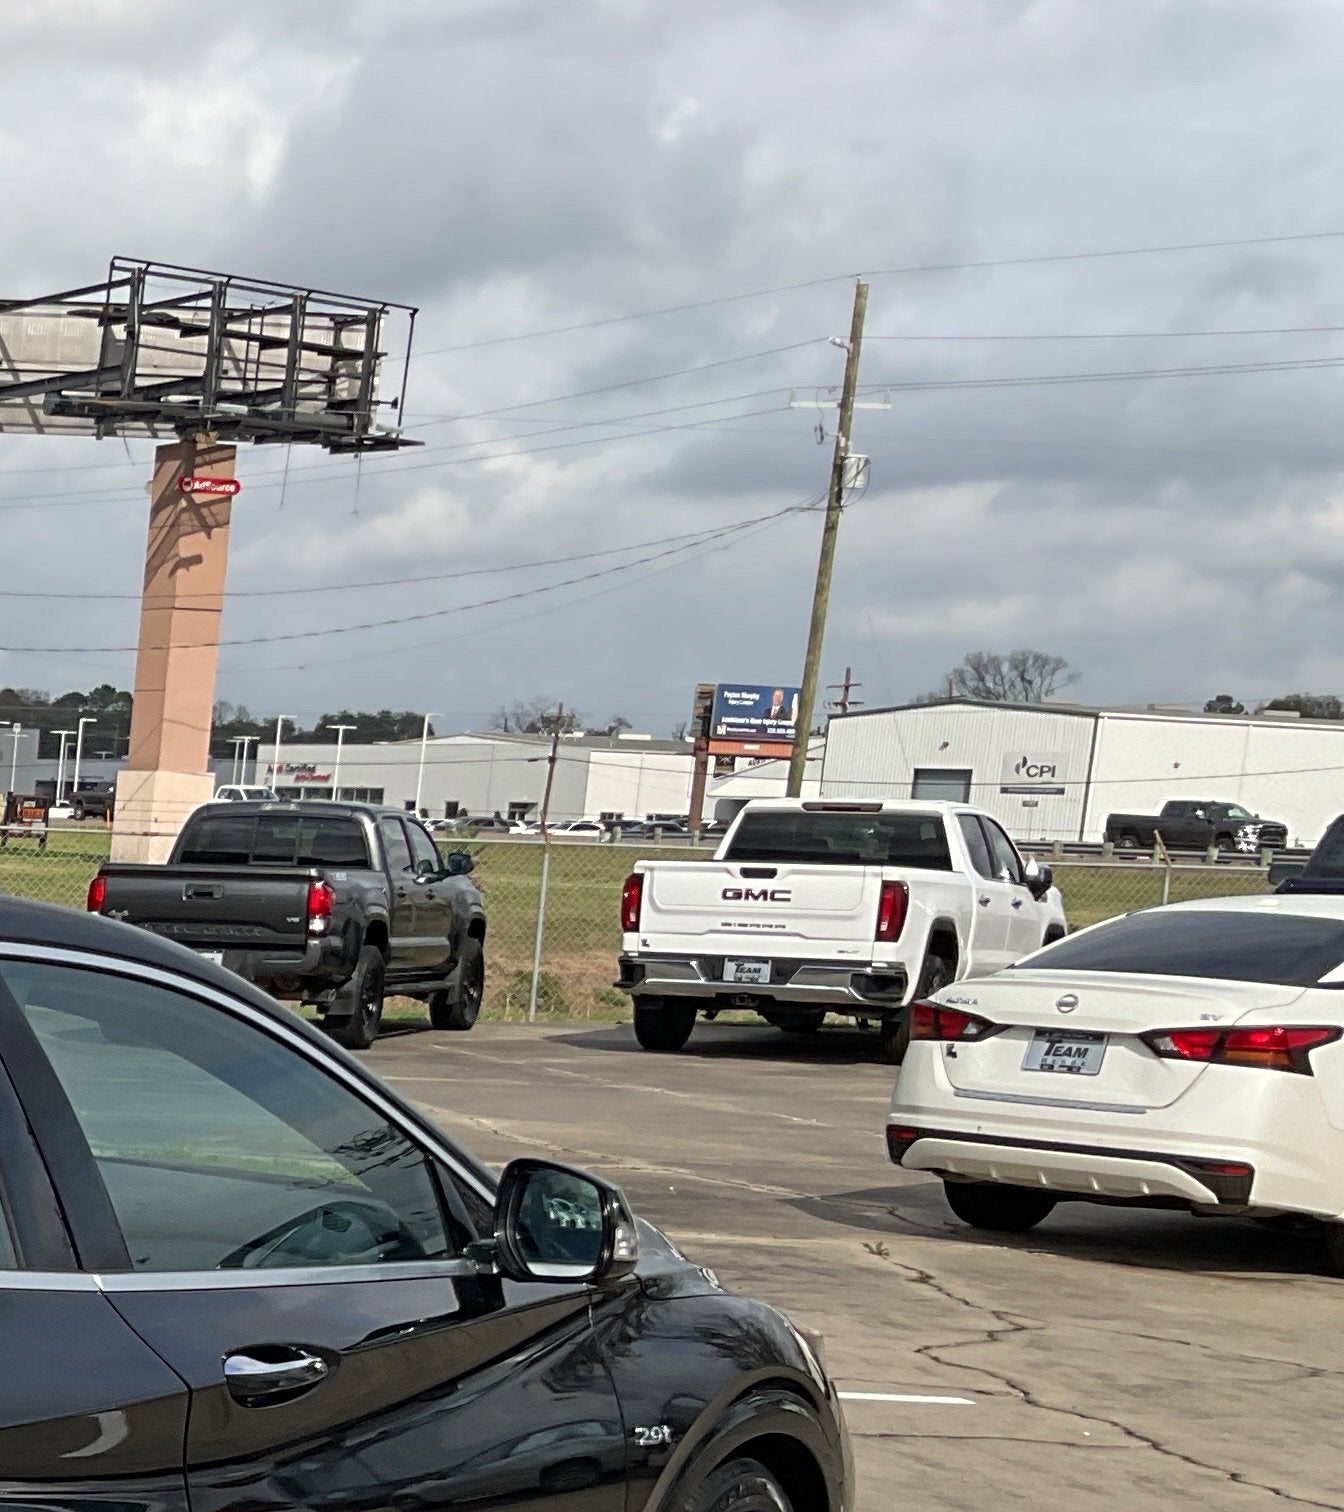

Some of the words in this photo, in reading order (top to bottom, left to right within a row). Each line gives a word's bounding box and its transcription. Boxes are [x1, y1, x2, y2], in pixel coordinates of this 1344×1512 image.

[1026, 764, 1056, 778] CPI
[721, 888, 792, 902] GMC
[734, 961, 762, 974] TEAM
[1043, 1039, 1089, 1059] TEAM
